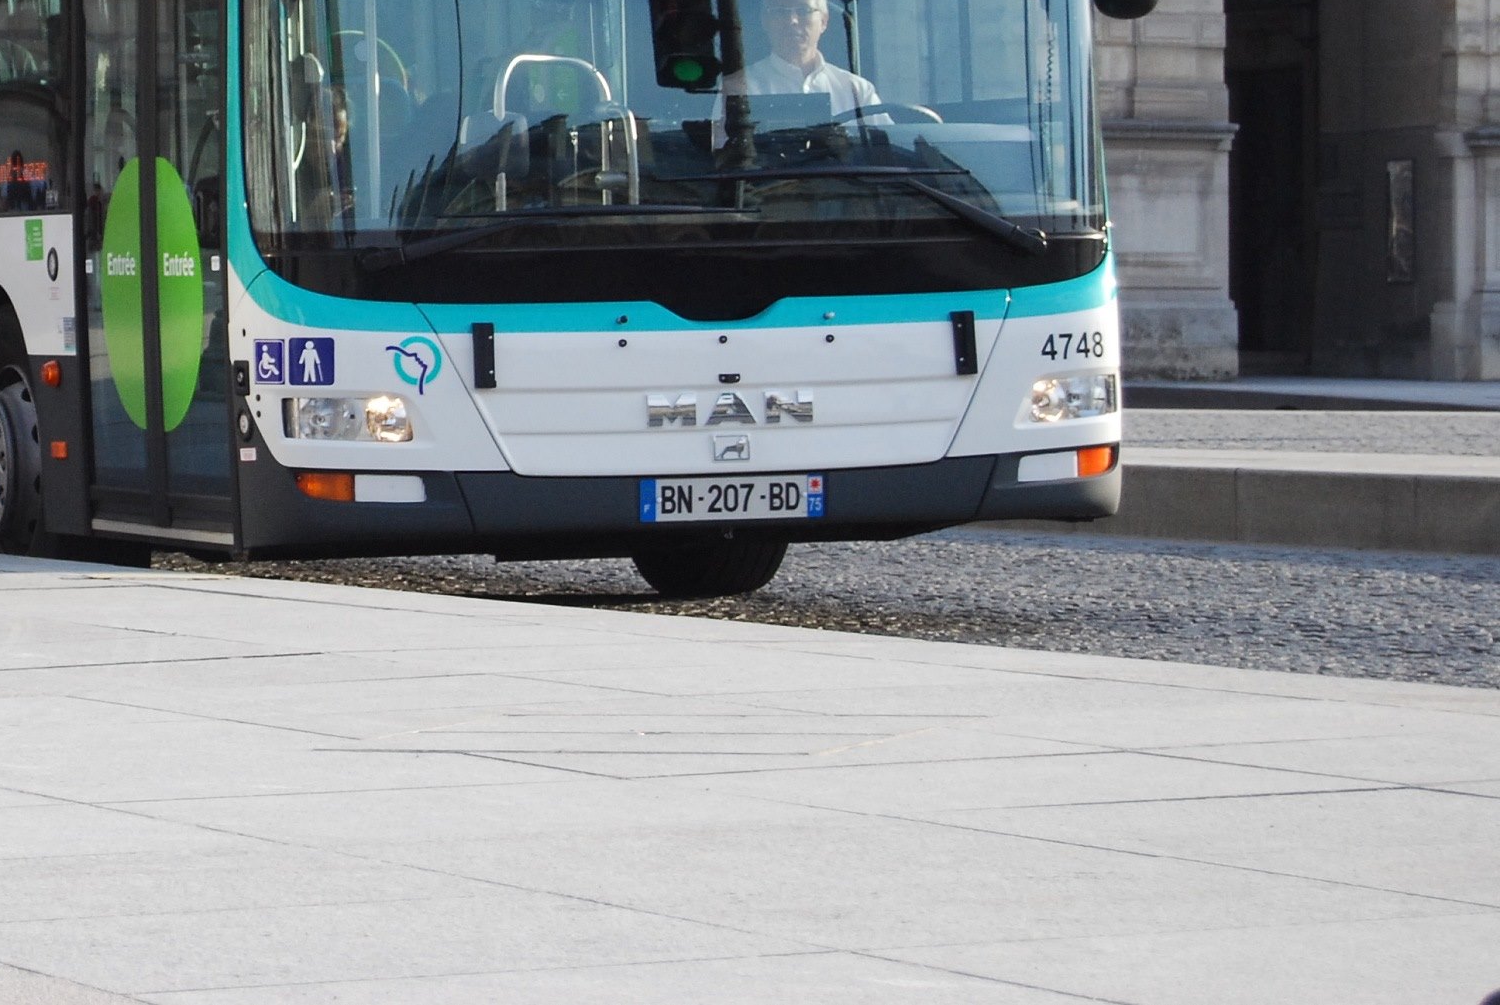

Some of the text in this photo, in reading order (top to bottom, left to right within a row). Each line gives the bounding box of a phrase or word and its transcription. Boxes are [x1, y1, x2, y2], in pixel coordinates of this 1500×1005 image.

[106, 251, 136, 276] Entrée
[163, 251, 195, 276] Entrée
[1041, 331, 1104, 361] 4748
[647, 389, 813, 427] MAN
[643, 504, 651, 513] F
[808, 497, 823, 511] 75
